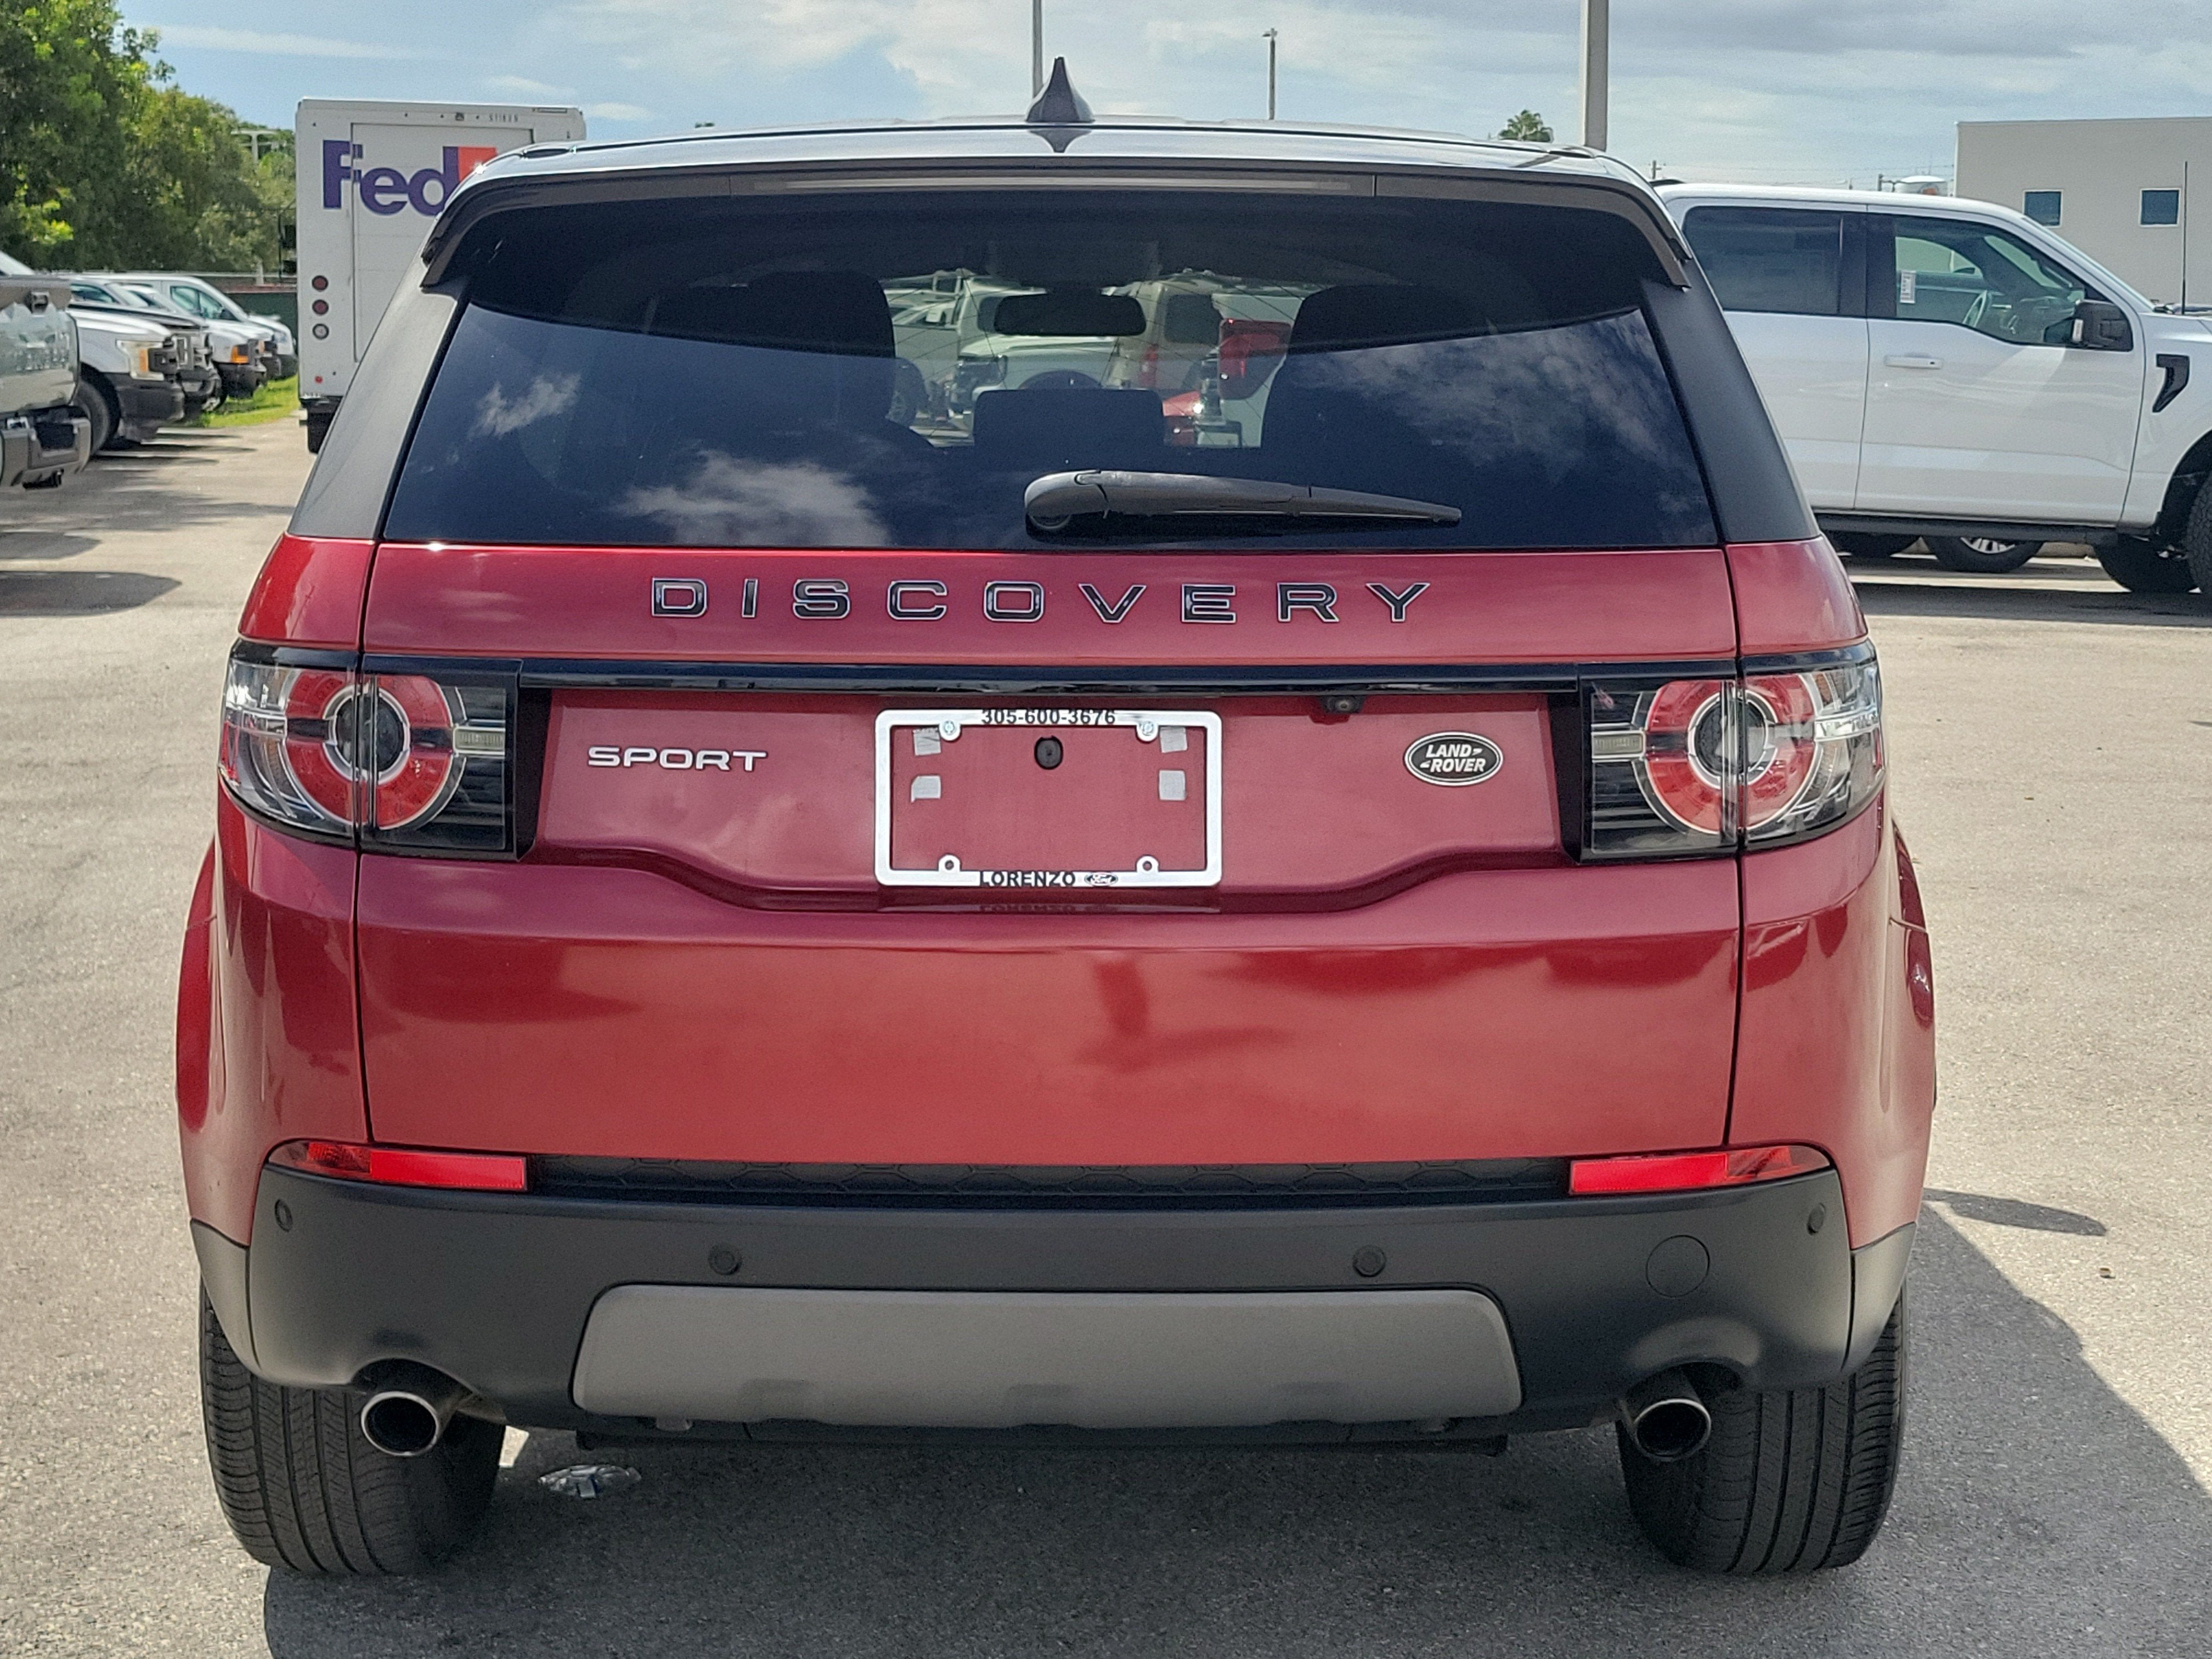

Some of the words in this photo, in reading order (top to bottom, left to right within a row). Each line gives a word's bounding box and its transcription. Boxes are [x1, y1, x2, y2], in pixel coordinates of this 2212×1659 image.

[323, 140, 498, 216] Fed
[652, 578, 1430, 623] DISCOVERY
[981, 709, 1115, 725] 305-600-3676
[588, 746, 767, 771] SPORT
[1426, 744, 1472, 758] LAND
[1430, 758, 1486, 772] ROVER
[980, 870, 1076, 887] LORENZO
